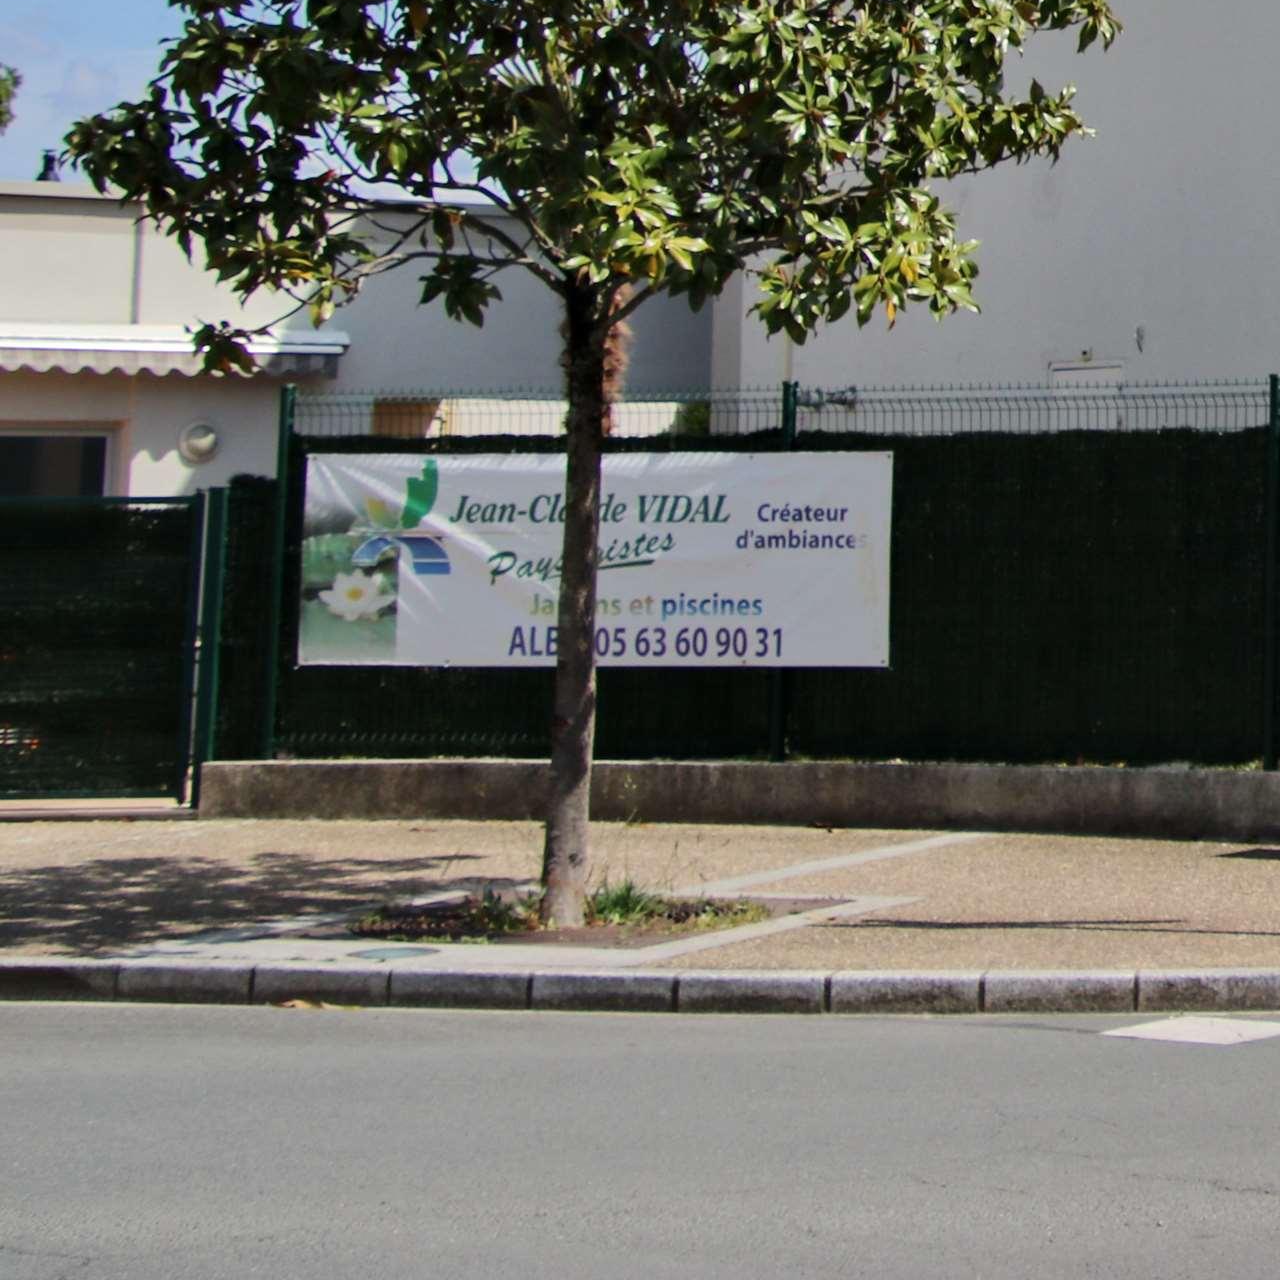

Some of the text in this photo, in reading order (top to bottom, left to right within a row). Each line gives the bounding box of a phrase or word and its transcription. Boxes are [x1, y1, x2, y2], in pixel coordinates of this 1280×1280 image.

[449, 493, 730, 524] Jean-Clade VIDAL
[757, 503, 848, 522] Créateur
[487, 532, 675, 586] Paysistes
[530, 593, 763, 620] Jans et piscines
[508, 626, 783, 657] ALB 05 63 60 90 31
